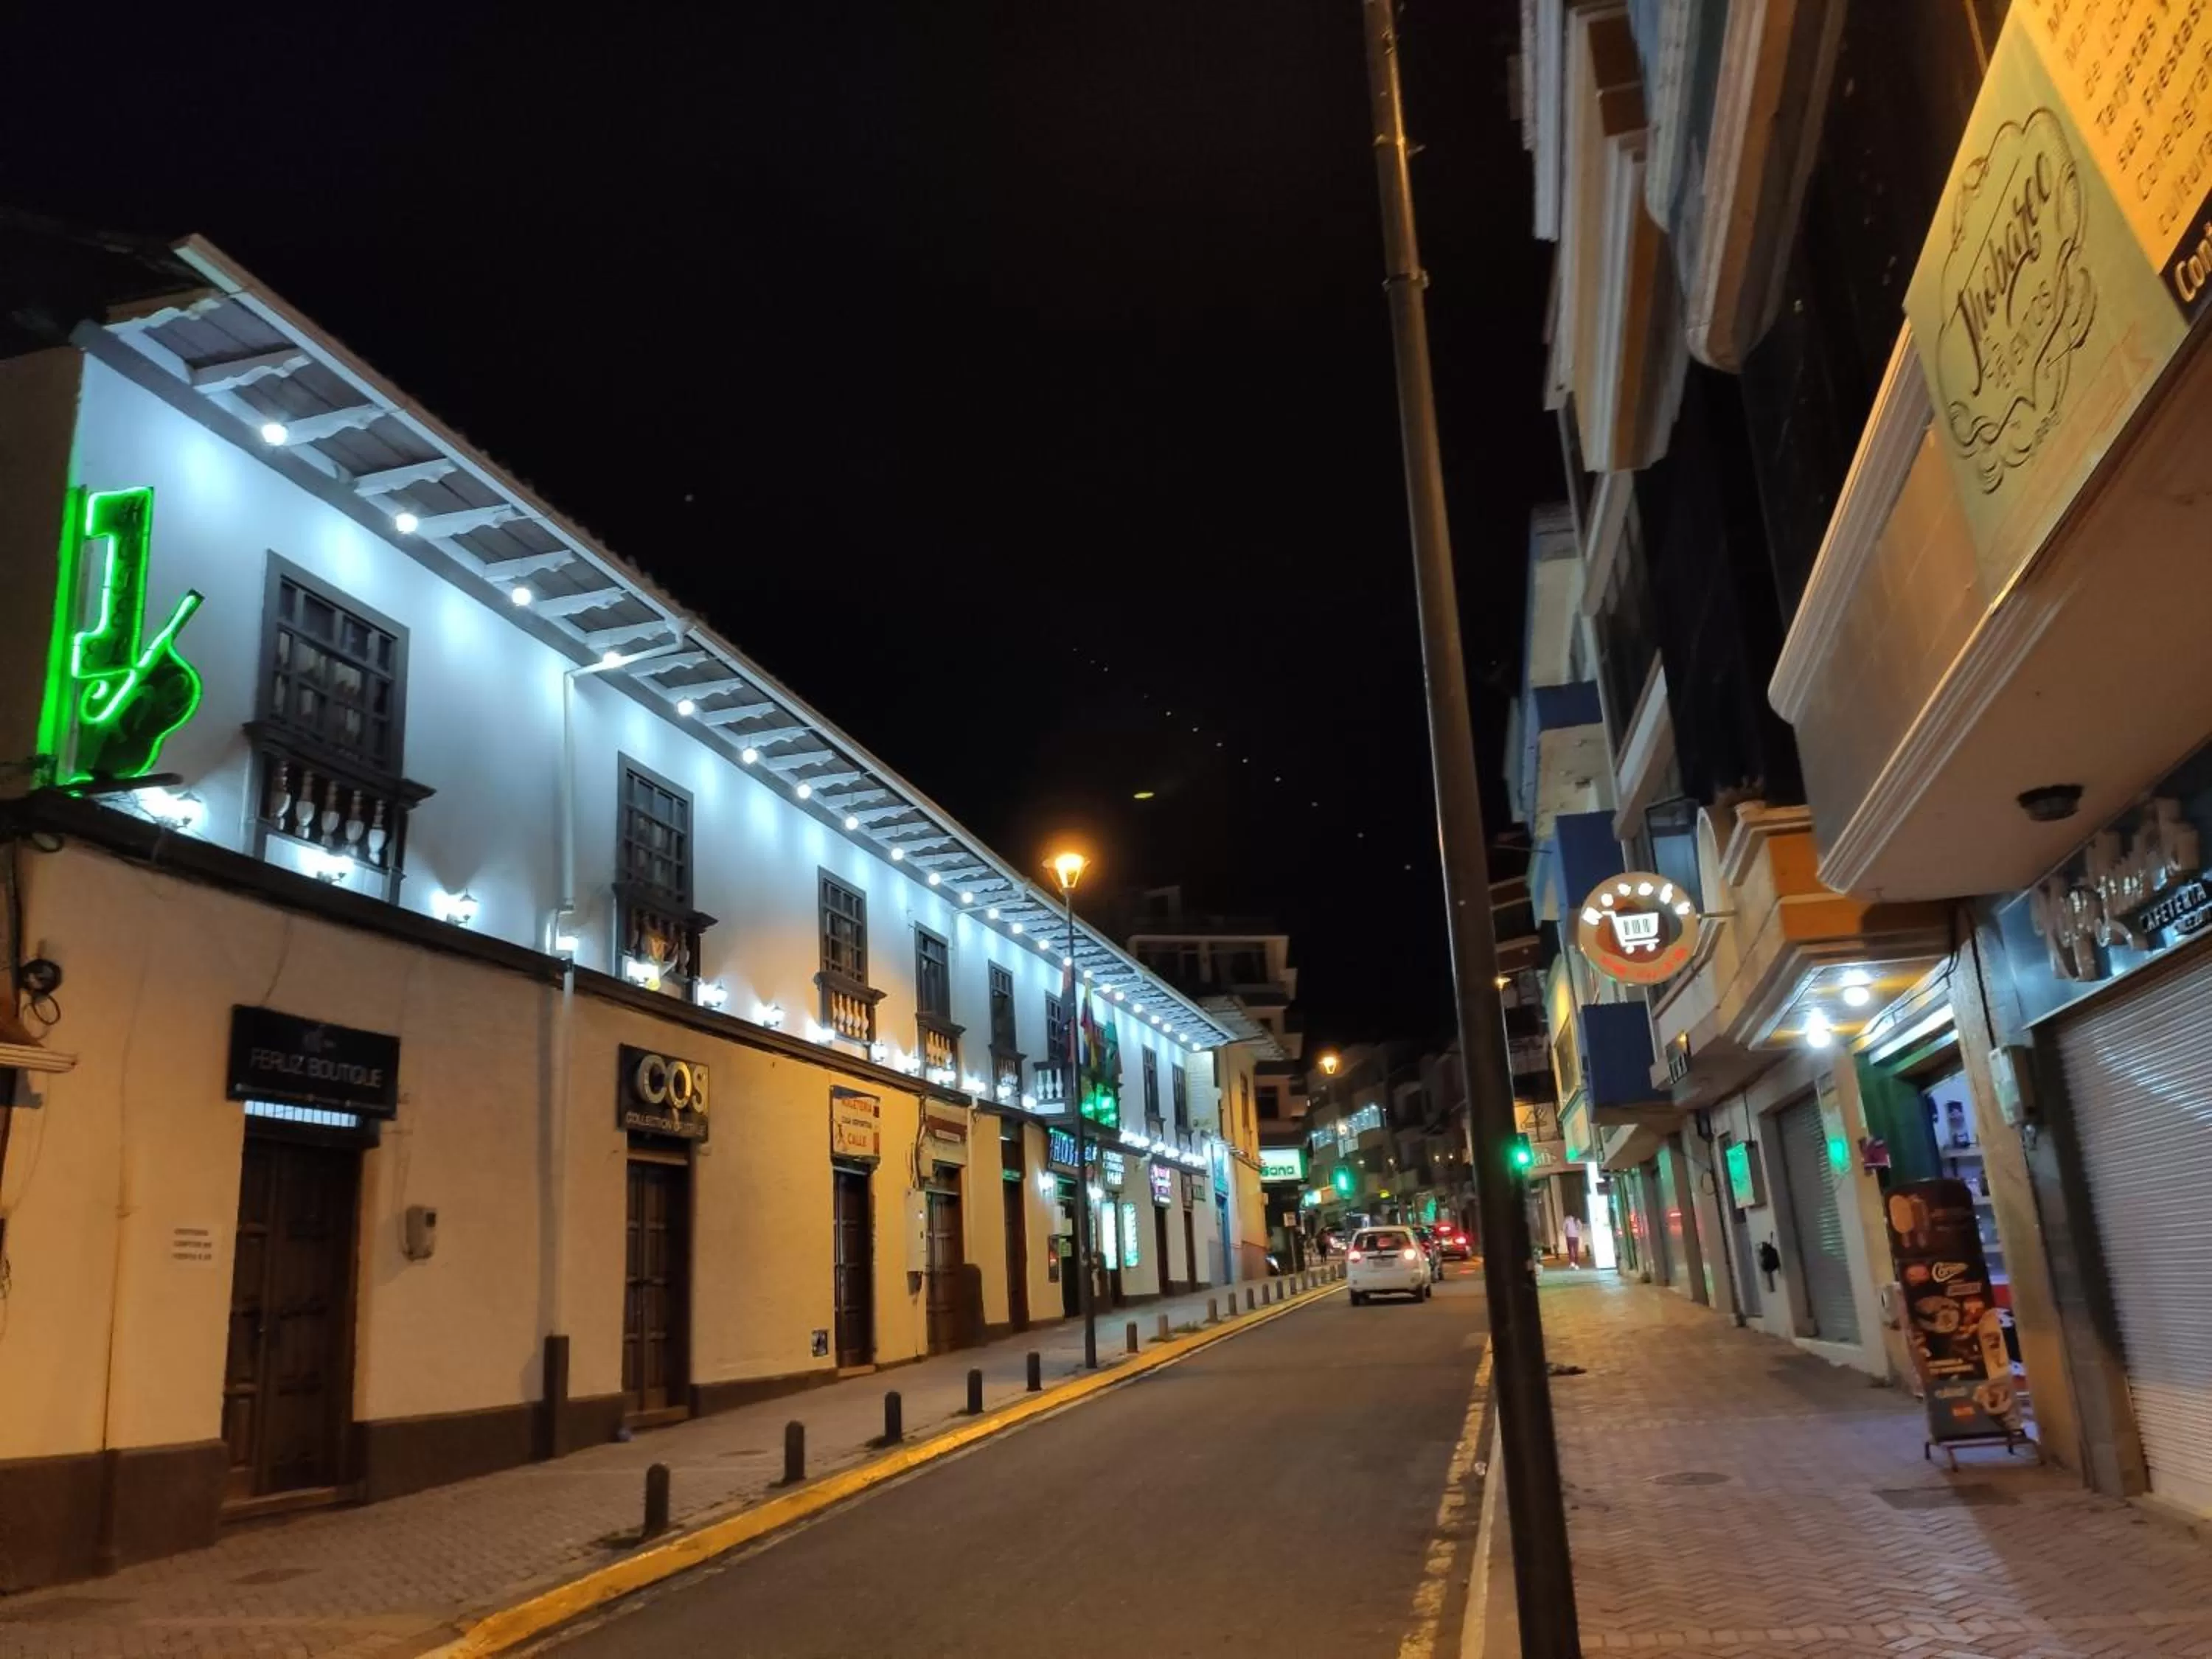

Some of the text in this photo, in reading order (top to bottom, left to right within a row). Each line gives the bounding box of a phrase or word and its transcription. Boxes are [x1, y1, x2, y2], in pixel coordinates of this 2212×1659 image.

[2095, 14, 2157, 136] Tarjetas
[2116, 118, 2143, 172] sus
[307, 1057, 383, 1088] BOUTIQUE
[636, 1054, 708, 1114] COS
